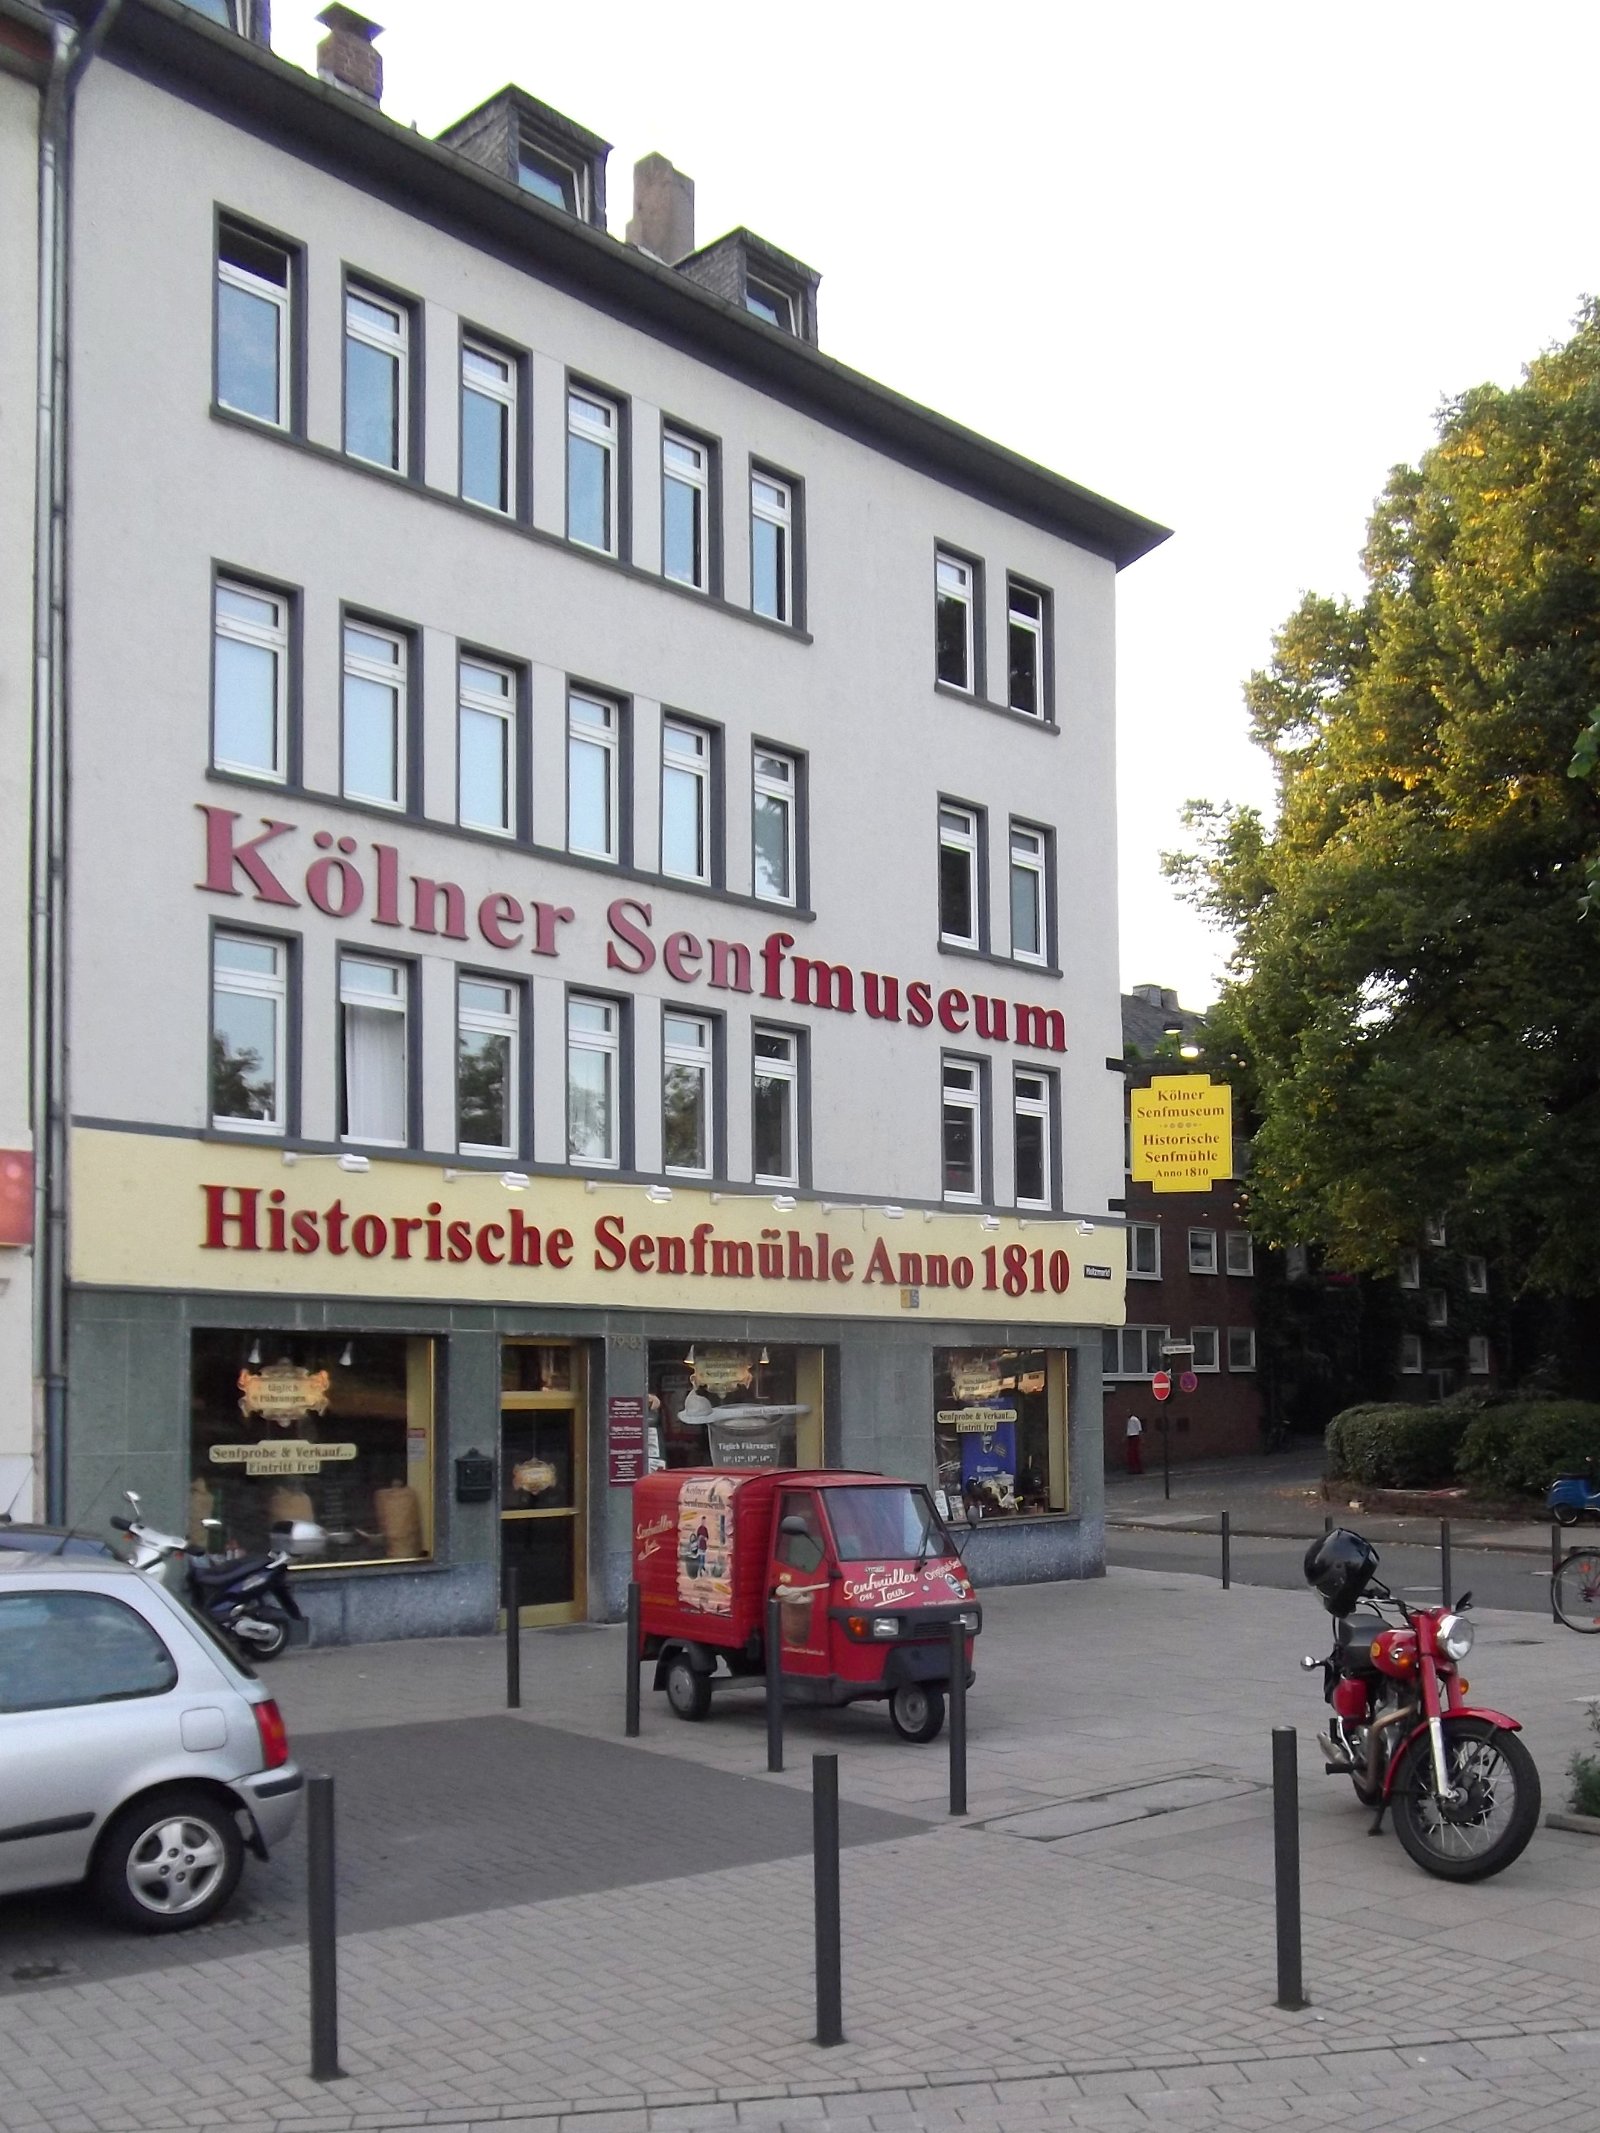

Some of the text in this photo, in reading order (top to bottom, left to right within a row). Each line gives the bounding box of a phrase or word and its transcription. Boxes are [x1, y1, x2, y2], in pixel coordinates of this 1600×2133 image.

[195, 804, 1068, 1053] Kölner Senfmuseum
[1158, 1089, 1205, 1101] Kölner
[1137, 1106, 1224, 1118] Senfmuseum
[1143, 1133, 1220, 1145] Historische
[1145, 1150, 1218, 1163] Senfmühle
[1185, 1168, 1208, 1177] 1810
[200, 1184, 1070, 1297] Historische Senfmühle Anno 1810
[939, 1411, 973, 1422] Senfprobe
[976, 1411, 981, 1420] &
[958, 1422, 996, 1432] Eintritt frei
[213, 1446, 353, 1461] Senfprobe & Verkauf...
[249, 1461, 319, 1472] Eintritt frei
[843, 1568, 918, 1600] Senfmüller
[860, 1587, 906, 1602] on Tour
